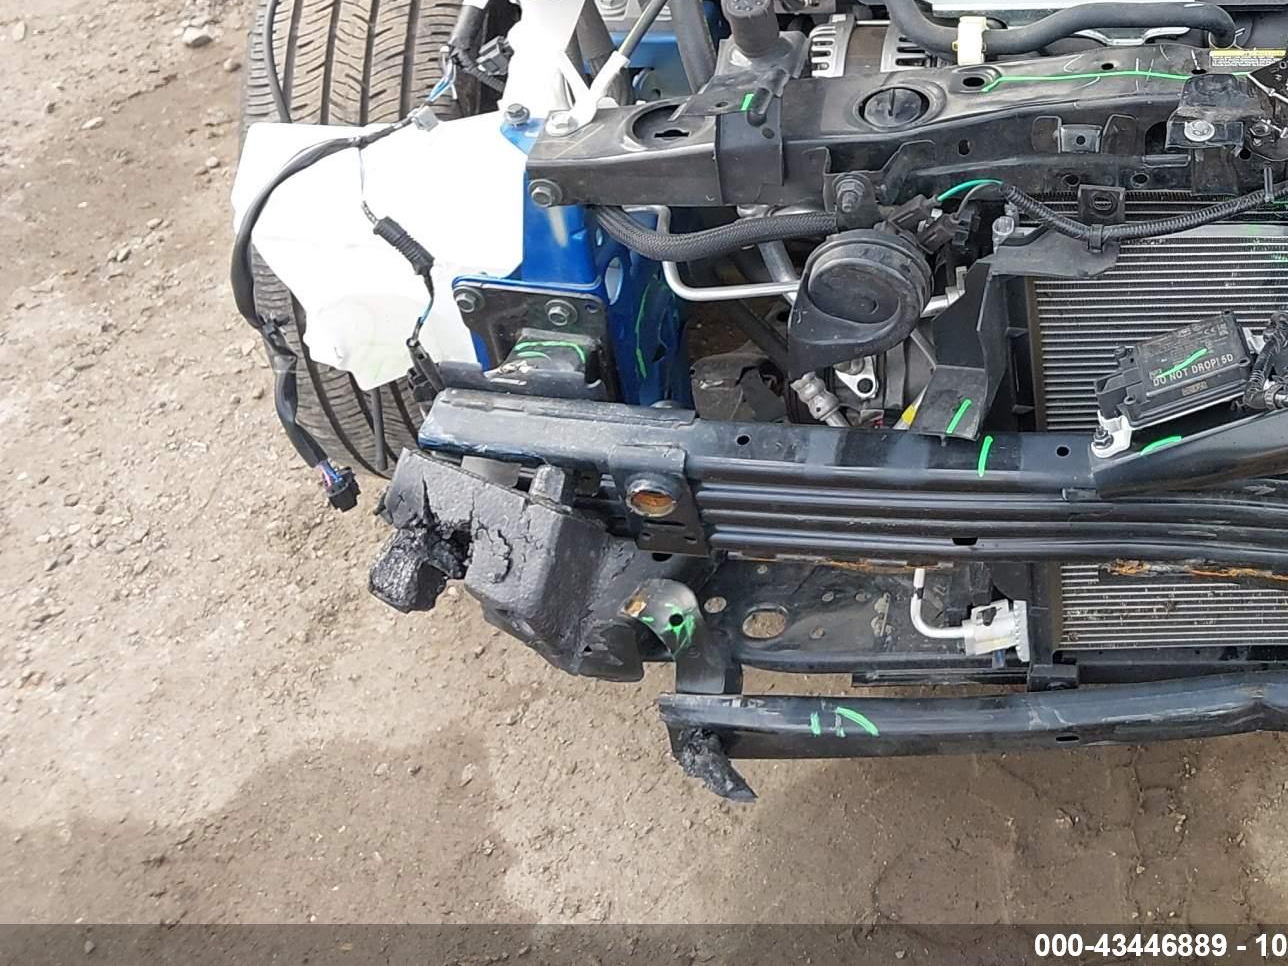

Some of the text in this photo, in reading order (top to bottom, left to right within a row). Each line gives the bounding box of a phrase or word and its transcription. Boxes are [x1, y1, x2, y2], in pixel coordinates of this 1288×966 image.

[1152, 353, 1234, 387] DO NOT DROP! 5D
